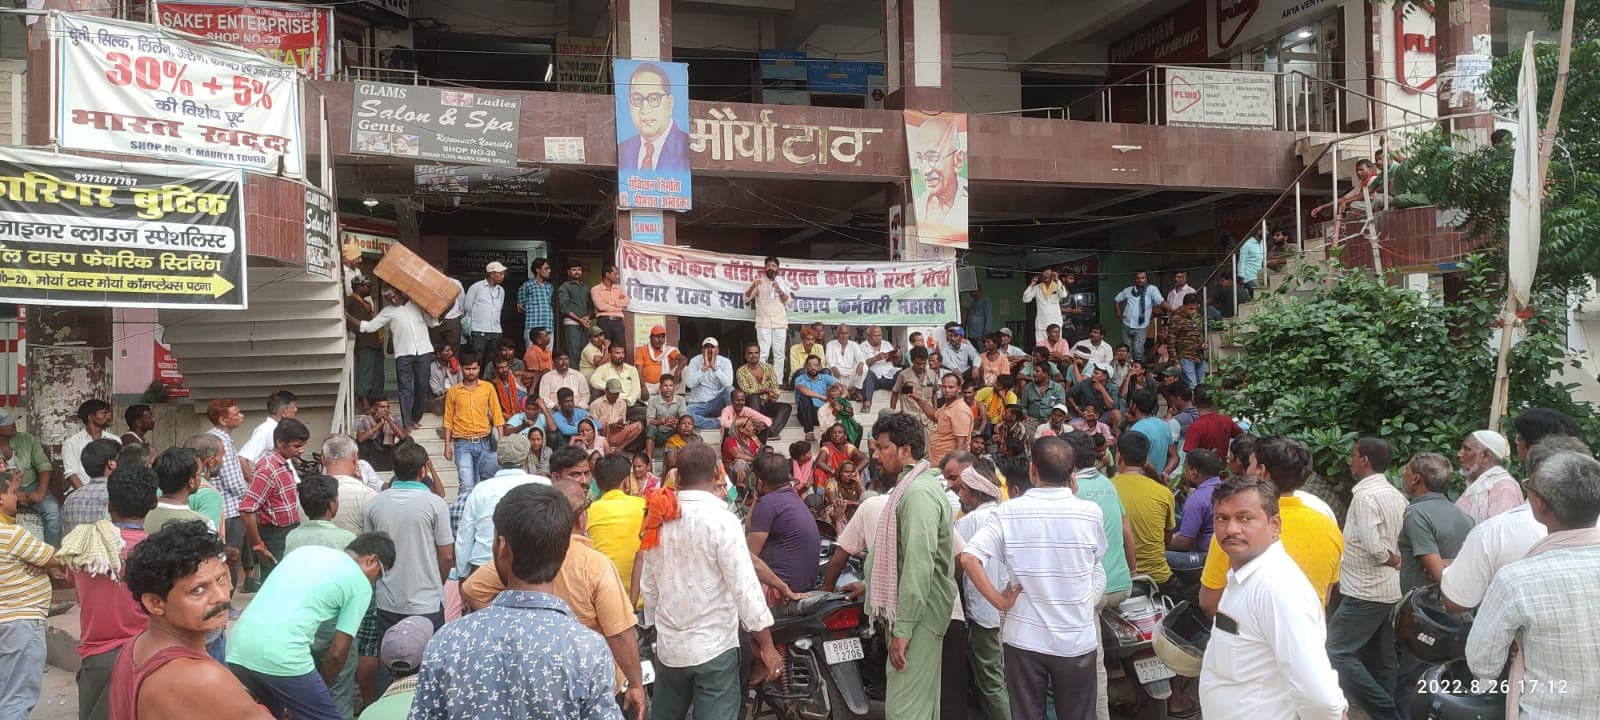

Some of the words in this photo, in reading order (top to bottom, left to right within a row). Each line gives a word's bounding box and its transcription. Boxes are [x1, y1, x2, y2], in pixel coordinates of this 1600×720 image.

[162, 12, 213, 29] SAKET
[217, 14, 319, 35] ENTERPRISES
[1281, 6, 1299, 20] ARYA
[206, 32, 239, 44] SHOP
[106, 52, 194, 97] 30%
[202, 76, 223, 95] +
[233, 75, 273, 110] 5%
[560, 73, 600, 83] STATIONER
[360, 84, 407, 99] GLAMS
[155, 98, 178, 113] की
[182, 99, 222, 121] विशेष
[476, 98, 517, 109] Ladies
[72, 109, 184, 138] भारत
[357, 100, 432, 123] Salon
[438, 107, 458, 126] &
[464, 110, 514, 134] Spa
[358, 119, 404, 134] Gents
[690, 107, 779, 162] मौर्या
[130, 141, 161, 151] SHOP
[196, 150, 234, 163] MAURYA
[442, 145, 468, 154] SHOP
[75, 173, 138, 187] 9572677787
[130, 184, 231, 220] बुटिक
[70, 225, 138, 244] ब्लाउज
[144, 225, 227, 249] स्पेशलिस्ट
[27, 250, 77, 267] टाइप
[82, 249, 155, 269] फेबरिक
[159, 252, 222, 271] स्टिचिंग
[622, 248, 662, 272] बिहार
[668, 255, 717, 279] लोकल
[824, 267, 877, 289] कर्मचारी
[883, 268, 917, 289] संघर्ष
[67, 276, 94, 288] टावर
[187, 281, 212, 292] पटना
[626, 278, 670, 304] बिहार
[675, 286, 712, 307] राज्य
[837, 293, 893, 315] कर्मचारी
[896, 294, 946, 315] महासंघ
